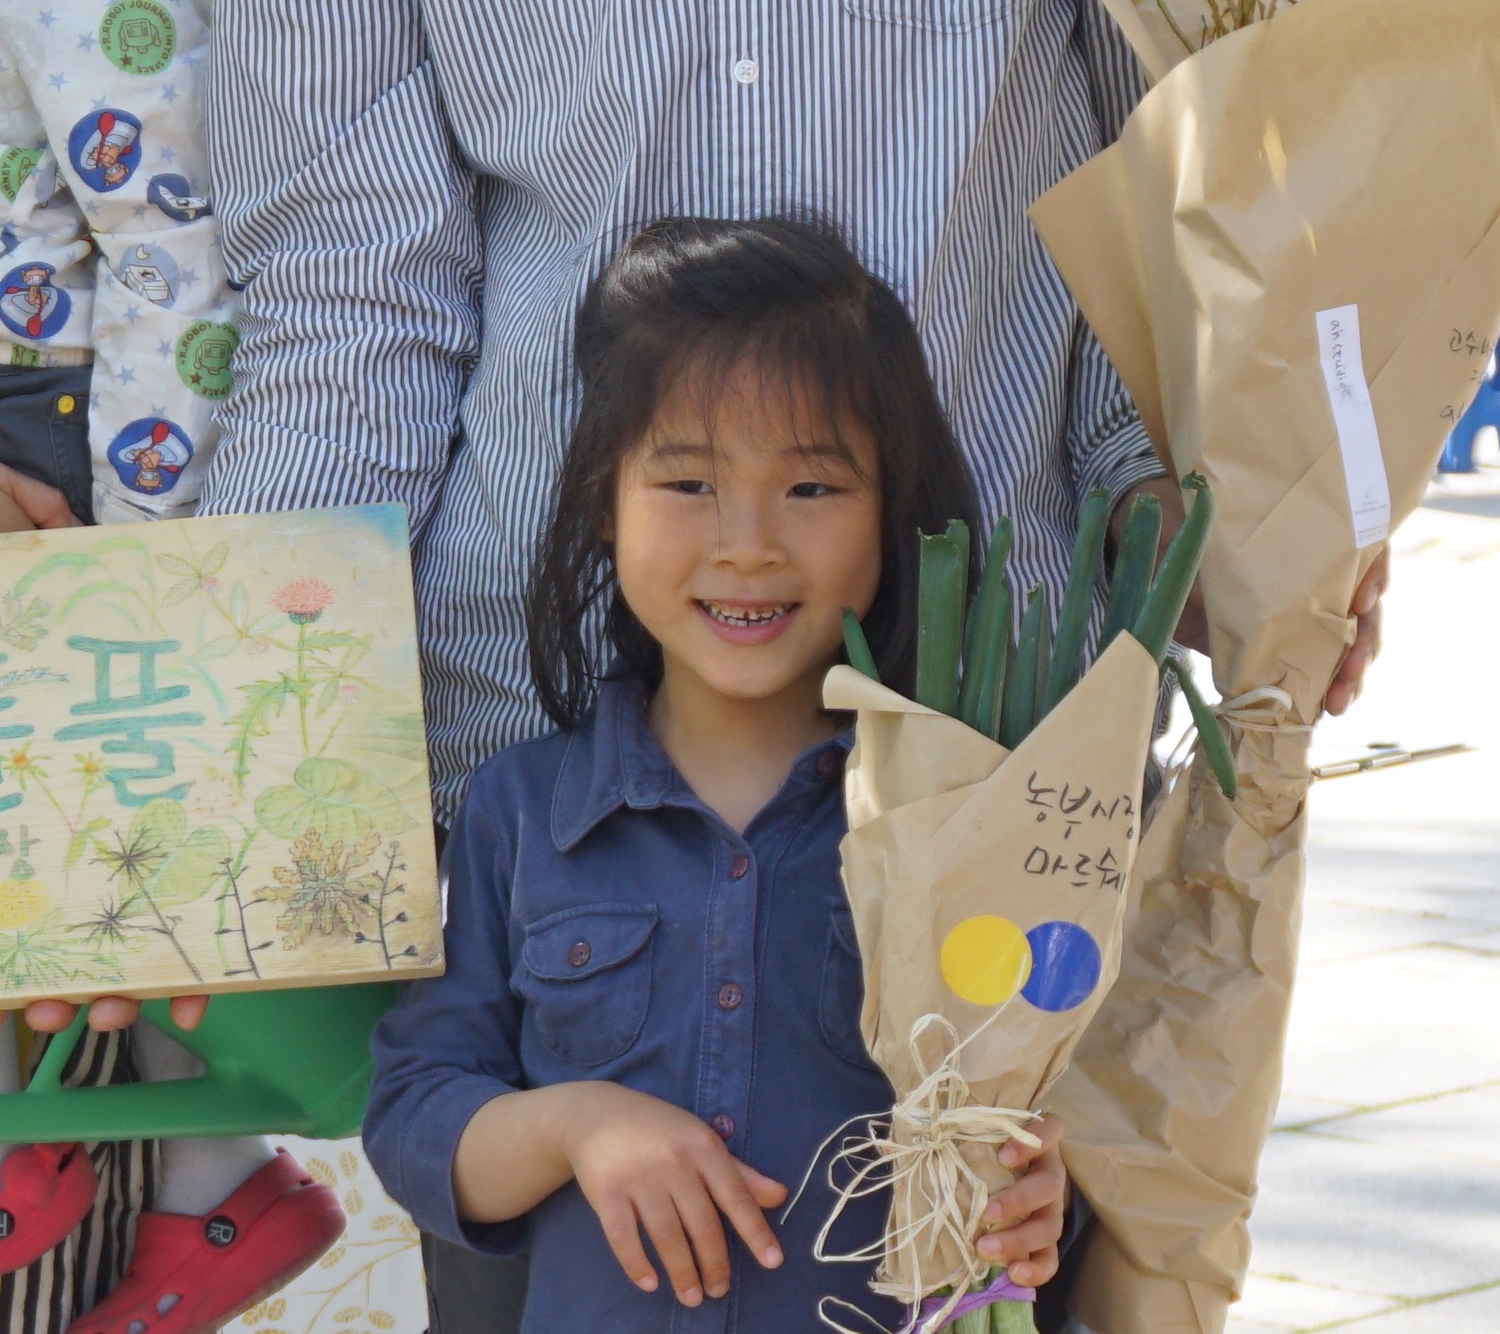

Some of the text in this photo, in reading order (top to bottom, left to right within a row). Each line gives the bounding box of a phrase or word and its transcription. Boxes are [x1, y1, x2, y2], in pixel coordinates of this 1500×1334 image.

[129, 0, 173, 31] JOURNEY
[161, 34, 173, 60] INTO
[1024, 845, 1126, 895] 마르쉐
